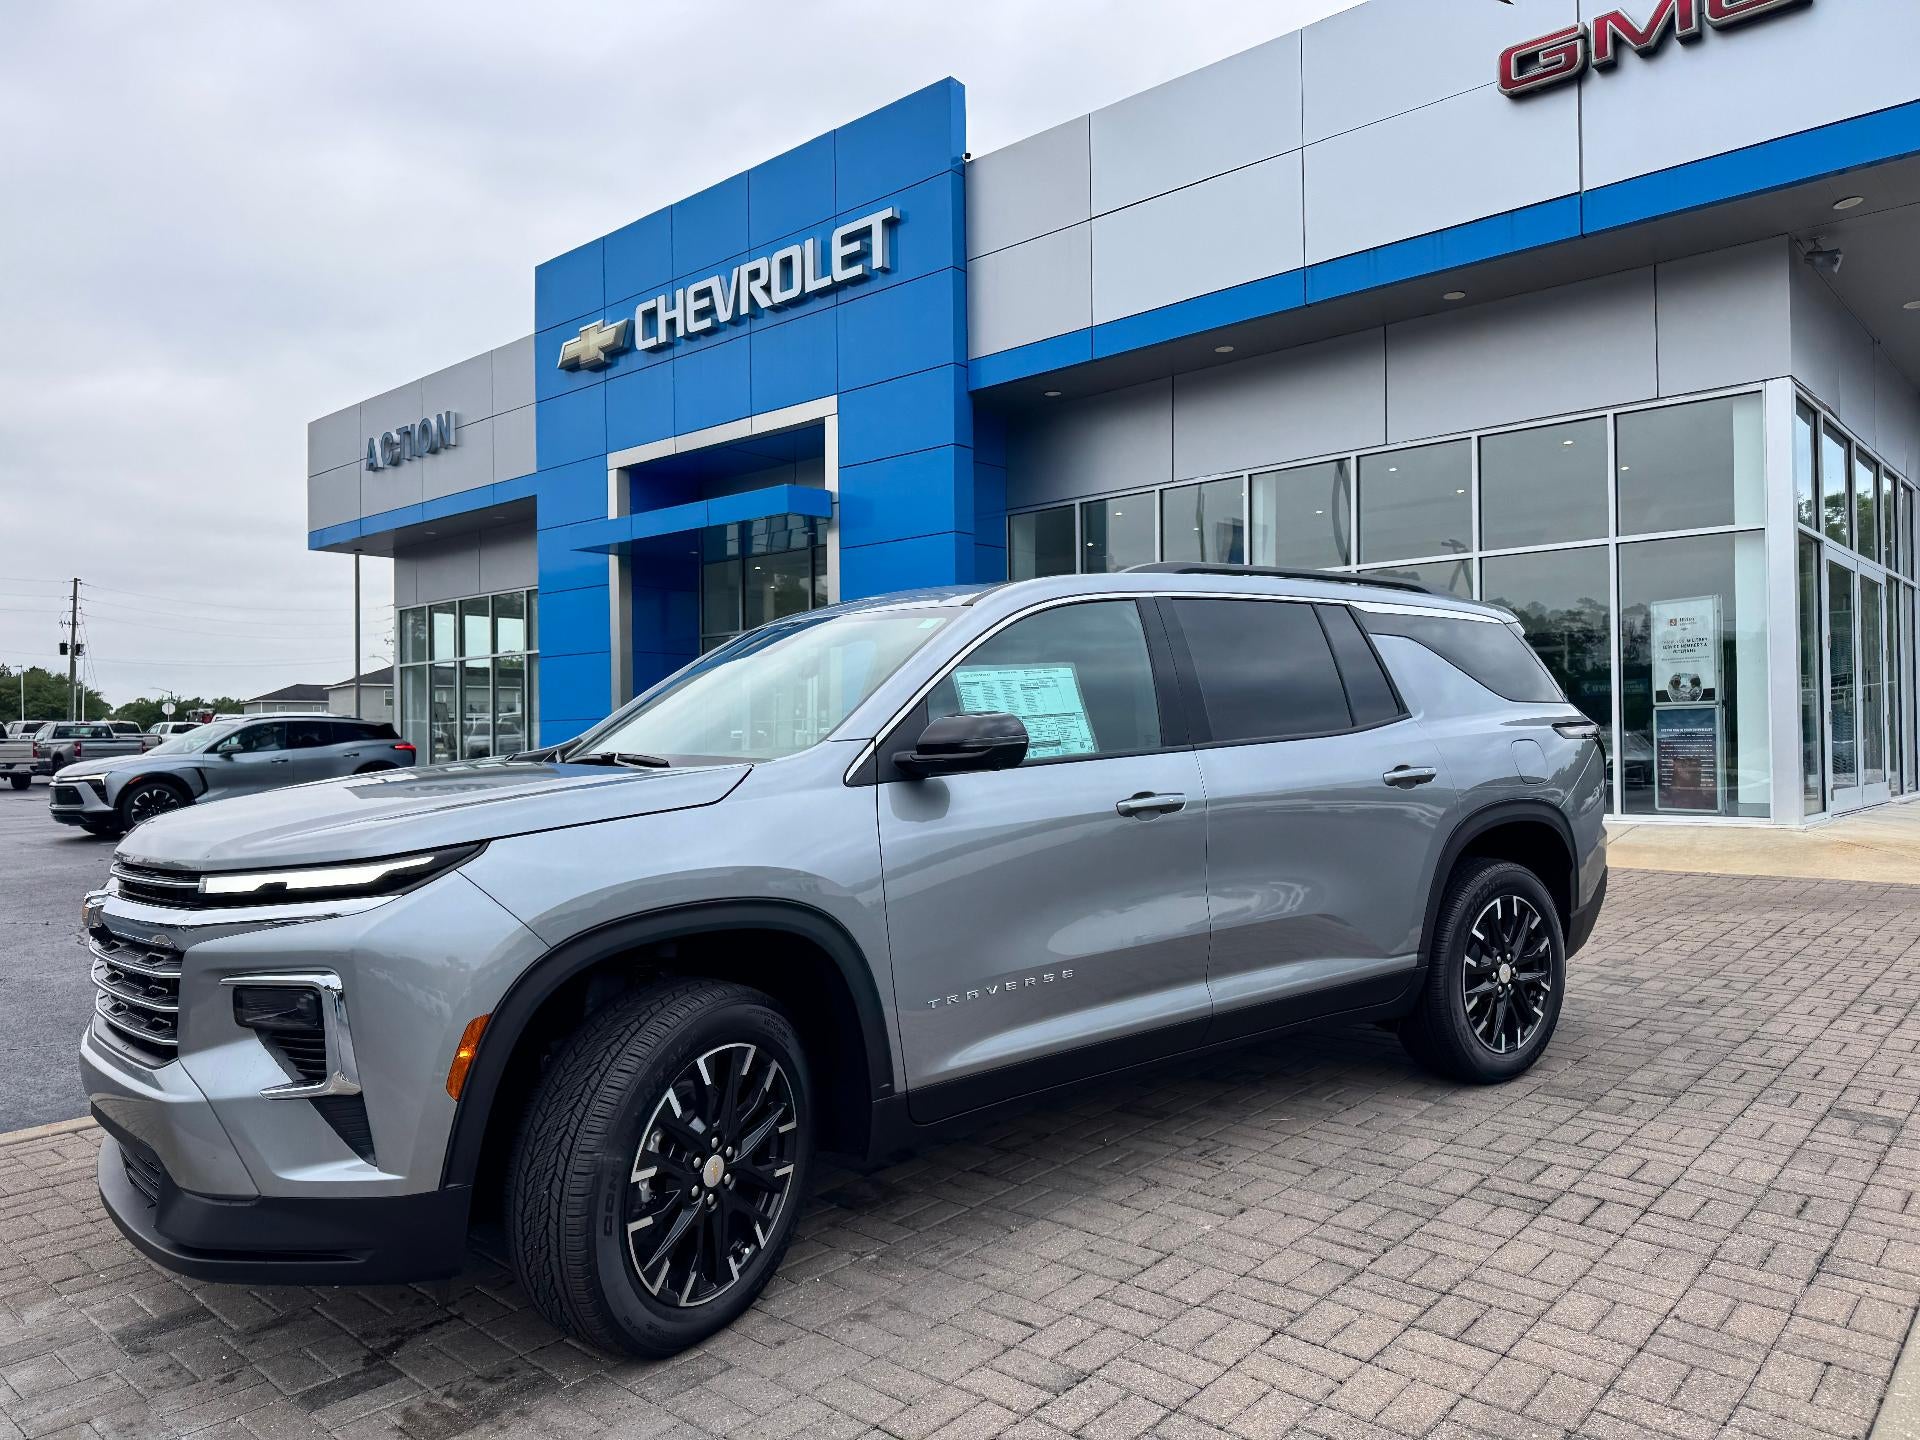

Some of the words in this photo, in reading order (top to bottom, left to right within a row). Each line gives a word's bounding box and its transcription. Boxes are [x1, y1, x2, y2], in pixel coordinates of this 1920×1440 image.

[635, 206, 901, 351] CHEVROLET
[365, 410, 457, 472] ACTION
[927, 969, 1074, 1009] TRAVERSE
